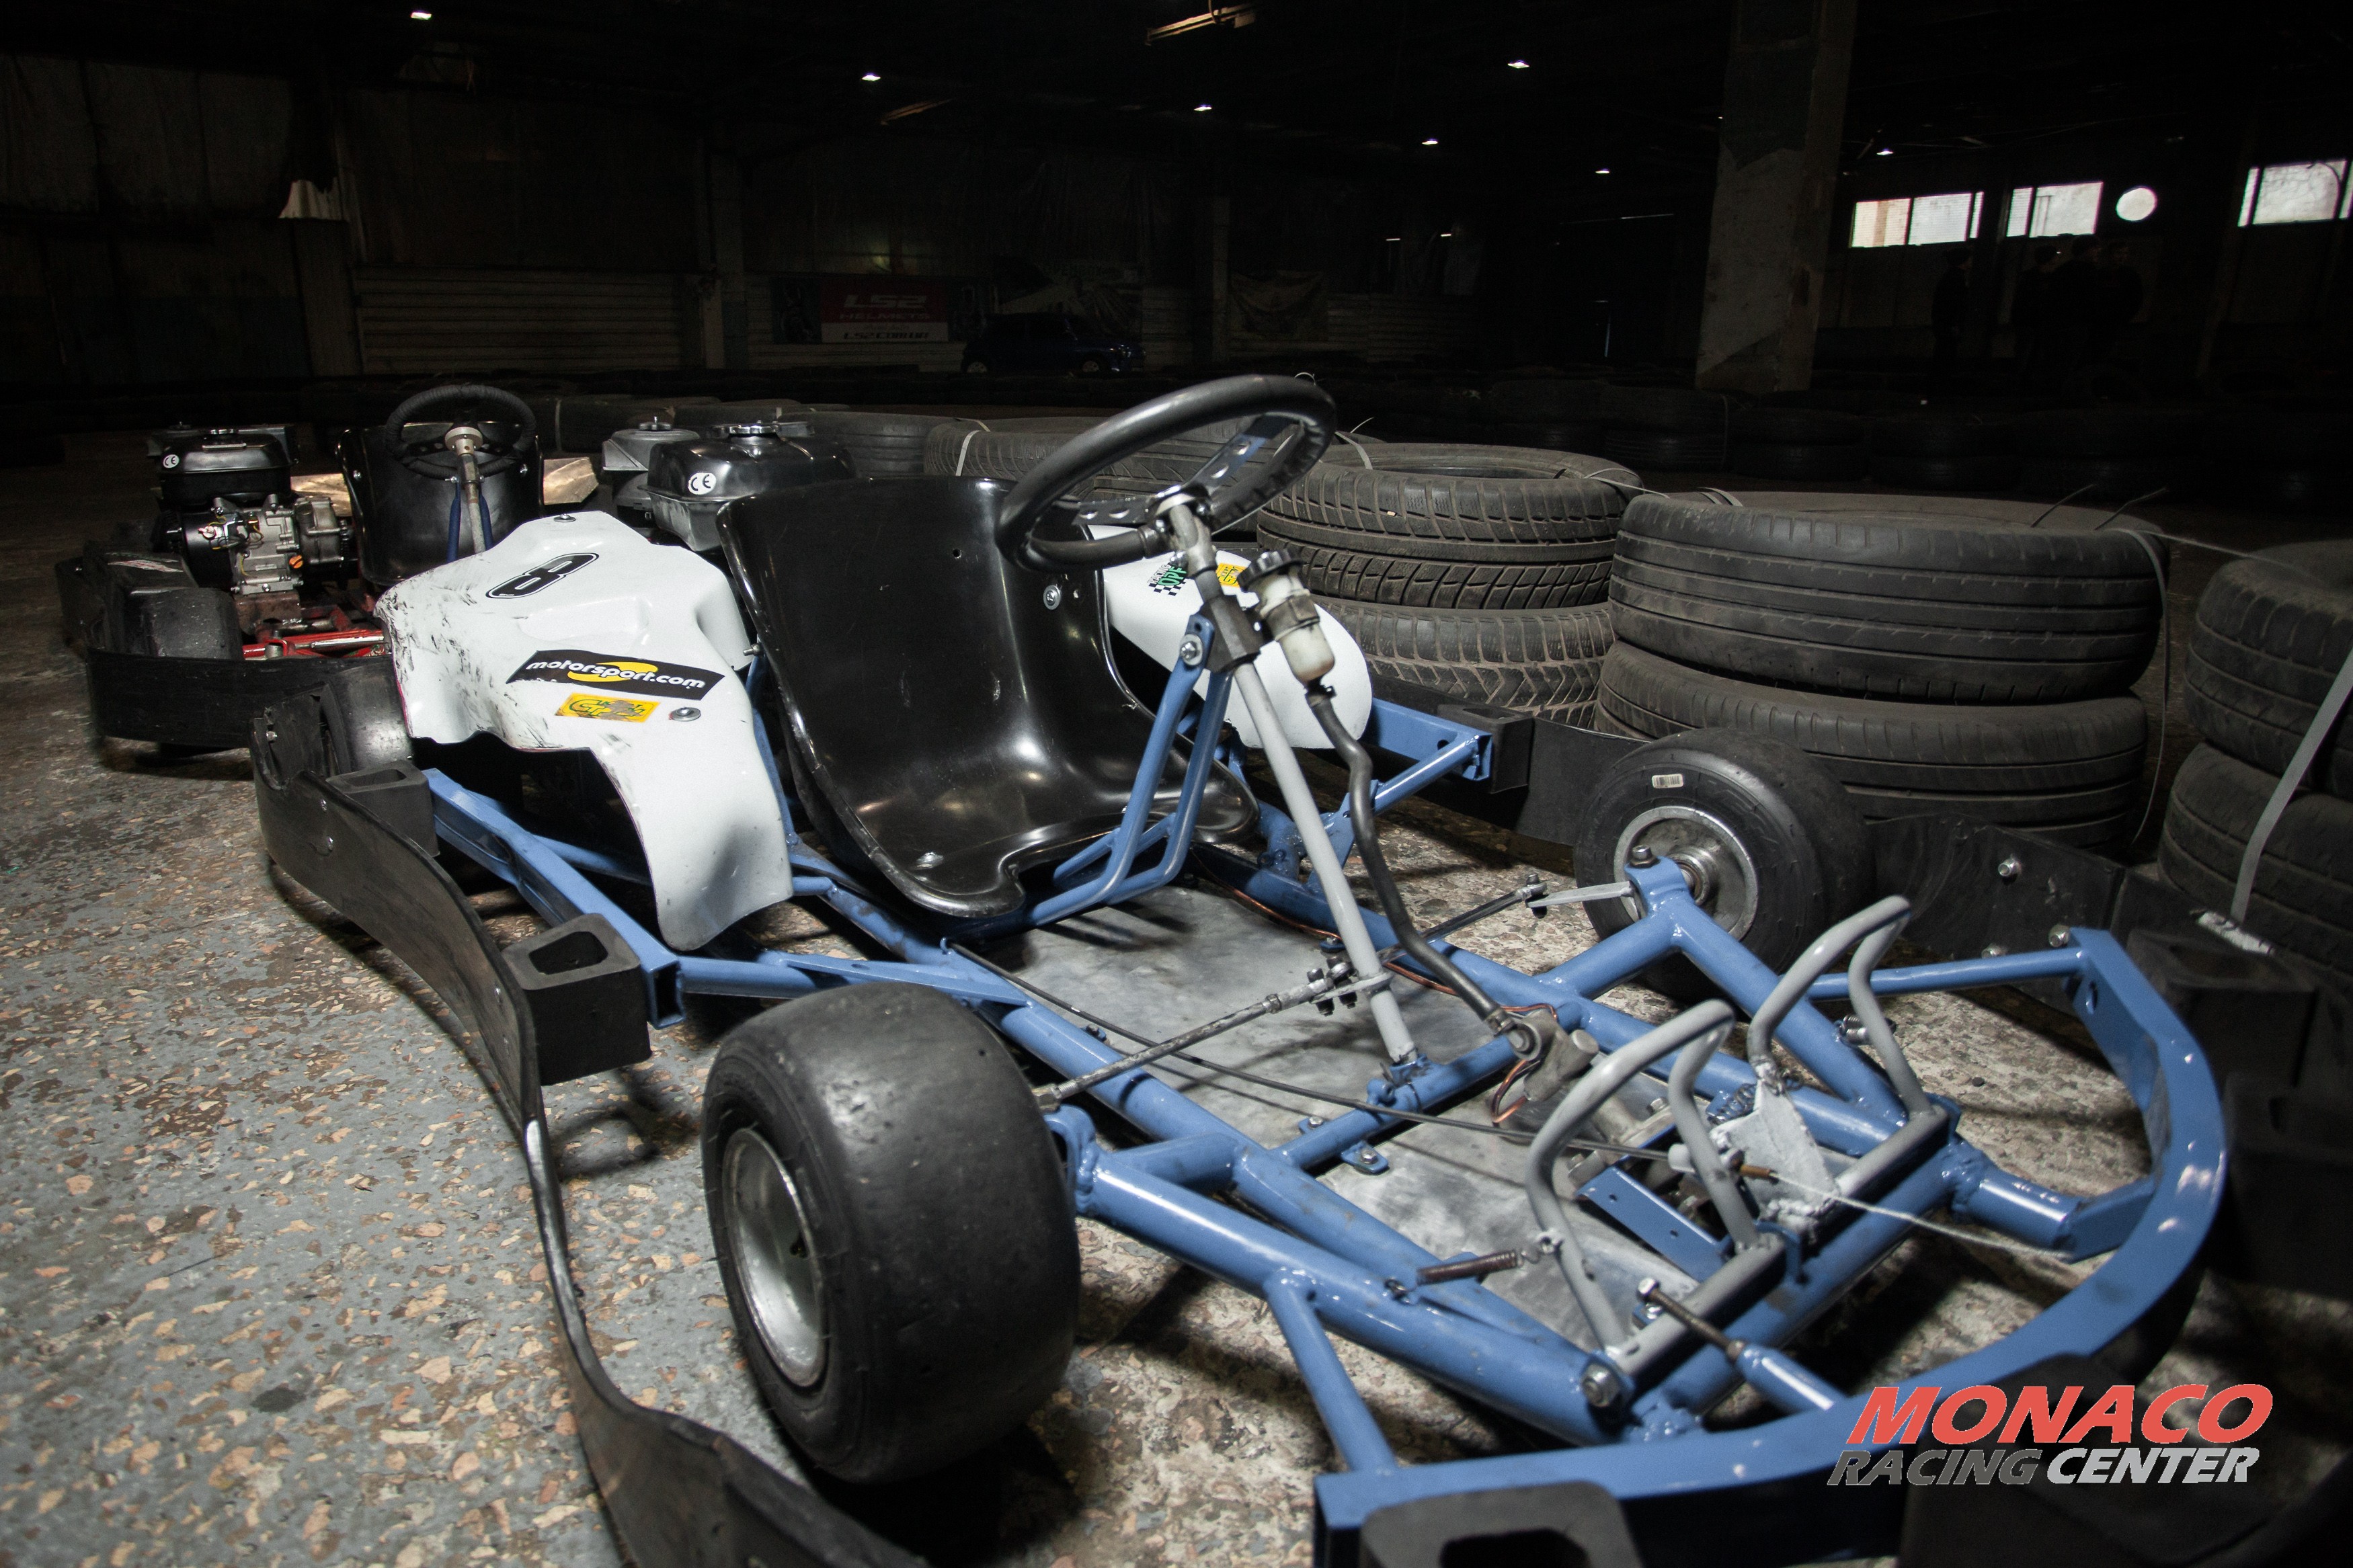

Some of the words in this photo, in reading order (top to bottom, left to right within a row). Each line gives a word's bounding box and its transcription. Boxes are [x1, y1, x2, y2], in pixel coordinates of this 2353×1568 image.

[843, 294, 926, 308] LS2
[690, 474, 711, 491] CE
[485, 552, 599, 598] 8
[526, 660, 706, 689] motorsport.com
